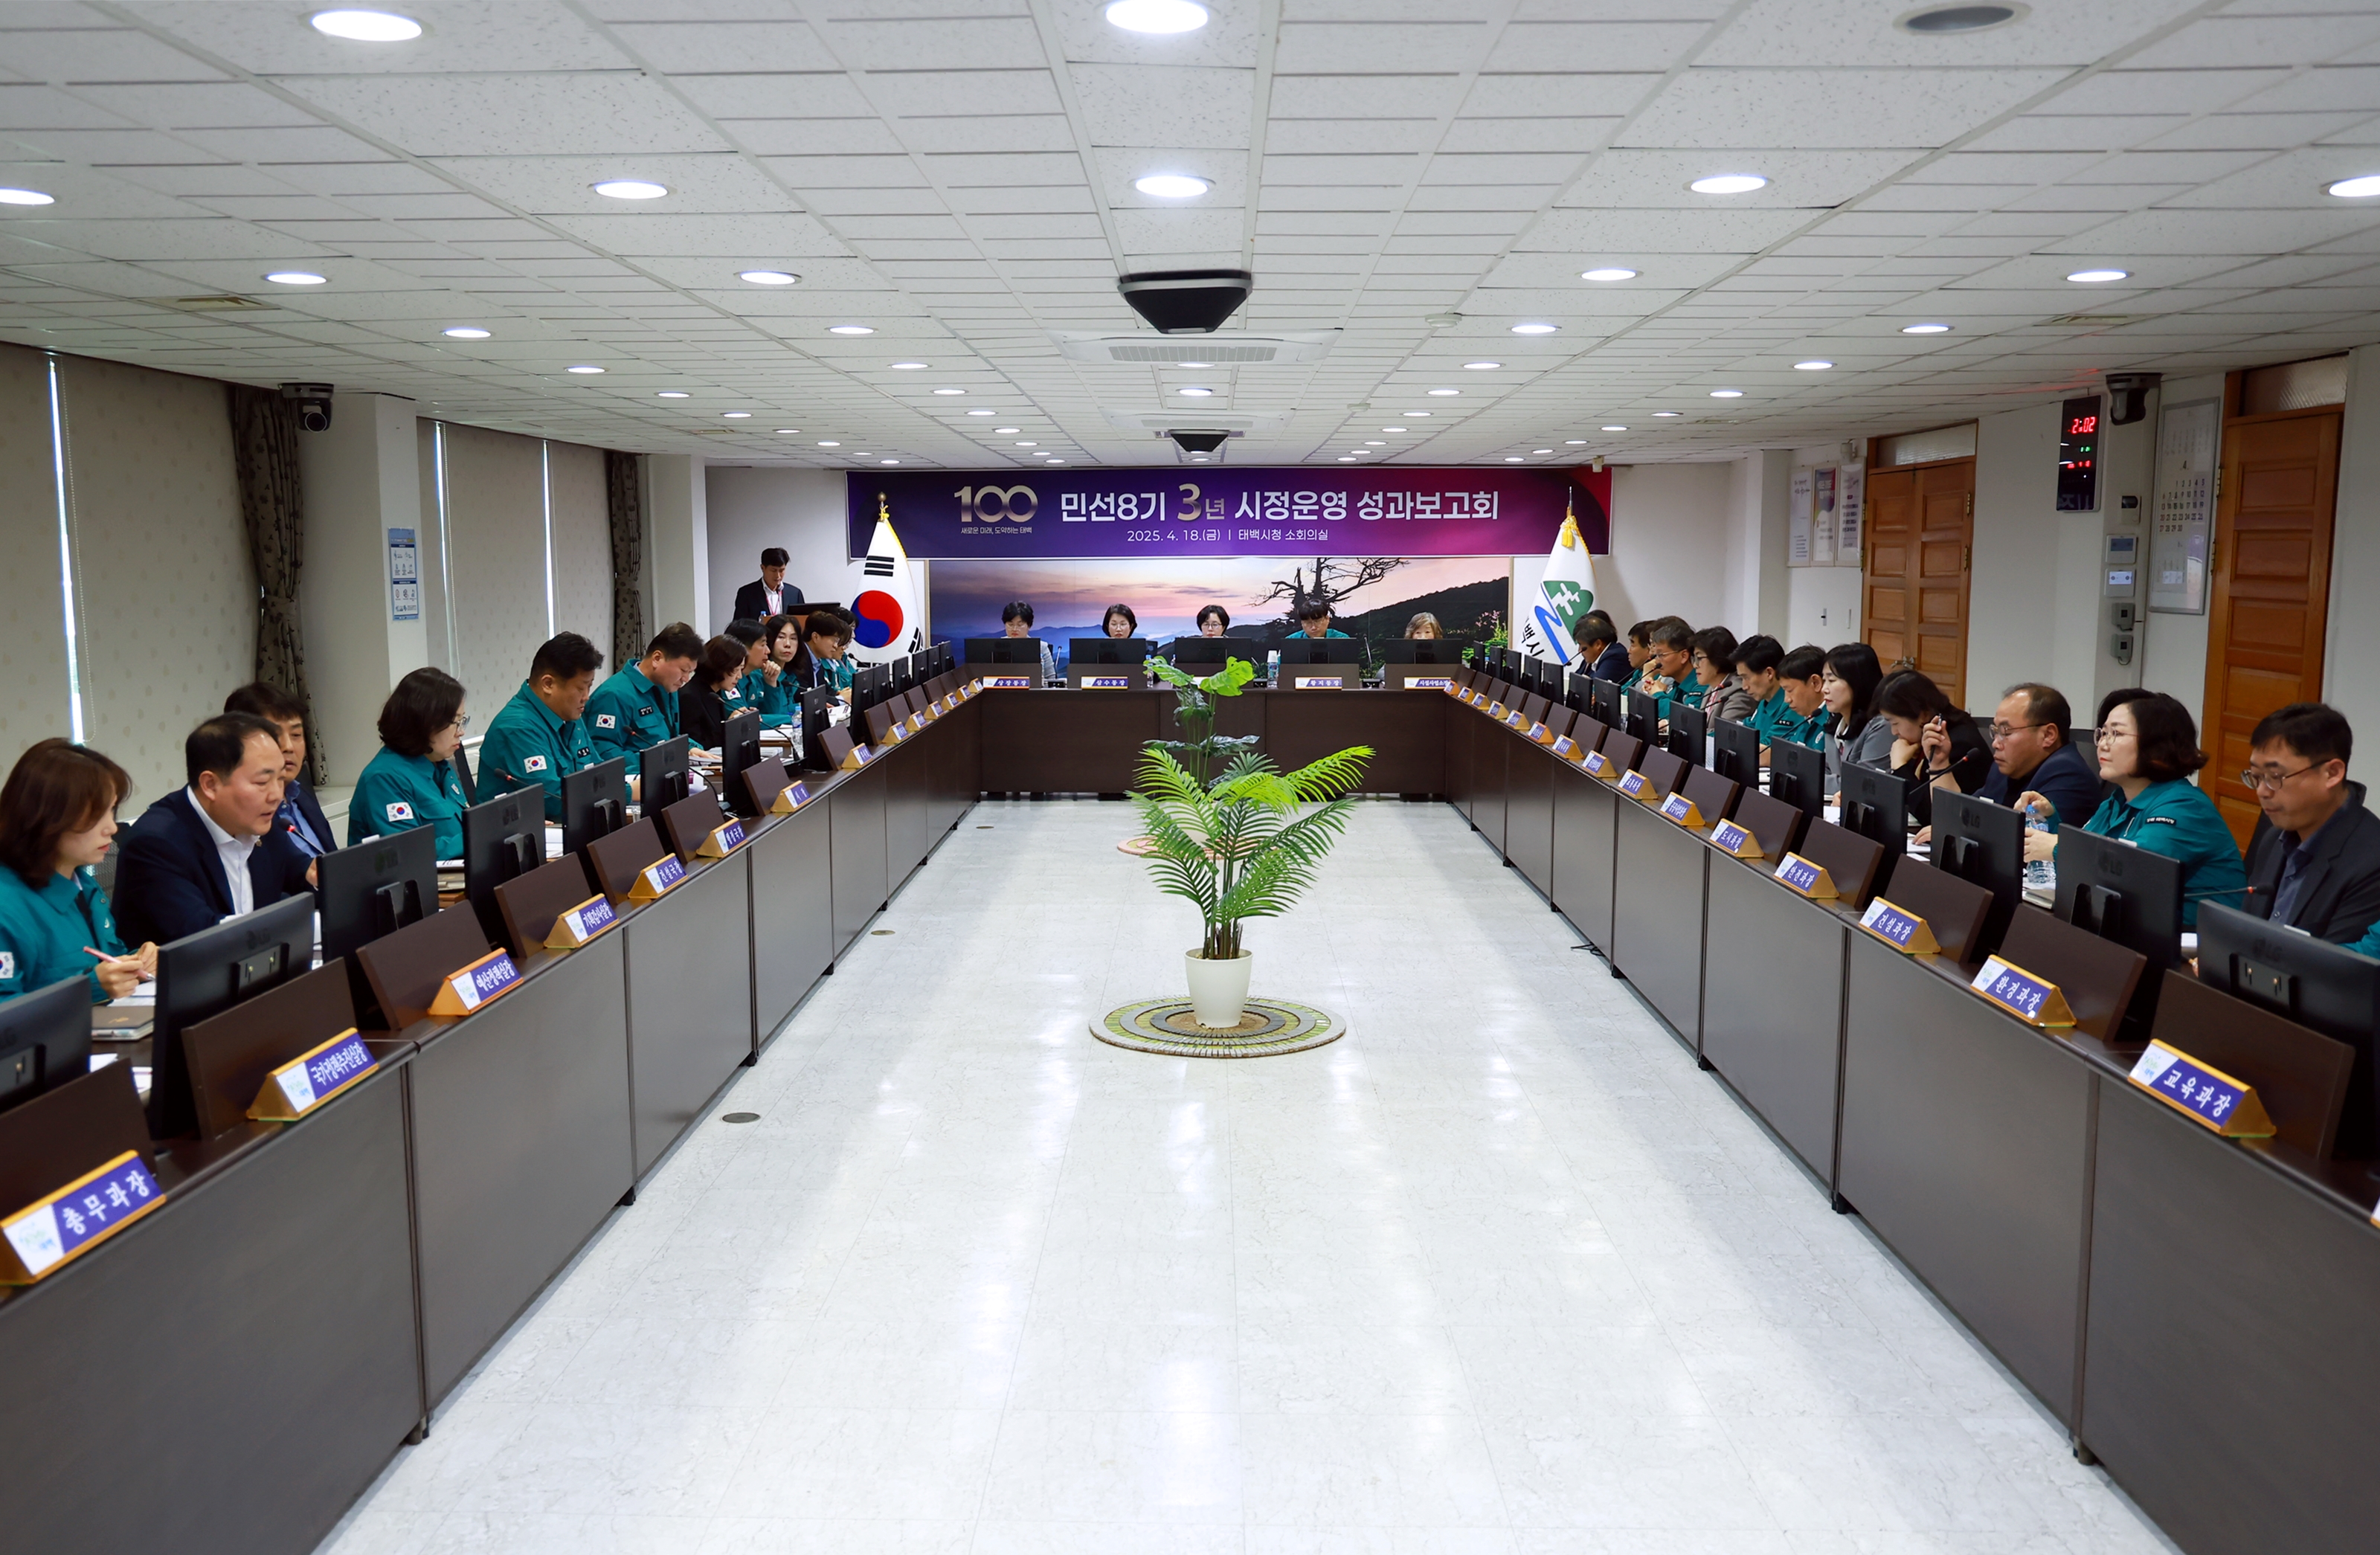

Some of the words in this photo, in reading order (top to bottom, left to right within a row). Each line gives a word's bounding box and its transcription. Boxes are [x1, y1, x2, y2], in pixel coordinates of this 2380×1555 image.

[953, 485, 1038, 523] 100
[1061, 492, 1165, 522] 민선8기
[1235, 491, 1347, 521] 시정운영
[1357, 491, 1499, 521] 성과보고회
[960, 527, 979, 535] 새로운
[980, 527, 994, 535] 미래,
[994, 527, 1019, 535] 도약하는
[1020, 527, 1032, 535] 태백
[1127, 530, 1163, 541] 2025.
[1167, 530, 1178, 541] 4.
[1183, 529, 1221, 542] 18.(금)
[1238, 529, 1281, 541] 태백시청
[1285, 529, 1329, 541] 소회의실
[1520, 615, 1545, 657] 백시
[1721, 831, 1743, 849] 도시과장
[1789, 866, 1815, 888] 안전과장
[582, 902, 613, 929] 기획감사실장
[1877, 913, 1912, 941] 건설과장
[476, 959, 515, 992] 예산정책실장
[1995, 975, 2042, 1011] 환경과장
[310, 1041, 368, 1086] 국가정책추진실장
[2163, 1069, 2232, 1118] 교육과장
[62, 1170, 150, 1235] 총무과장
